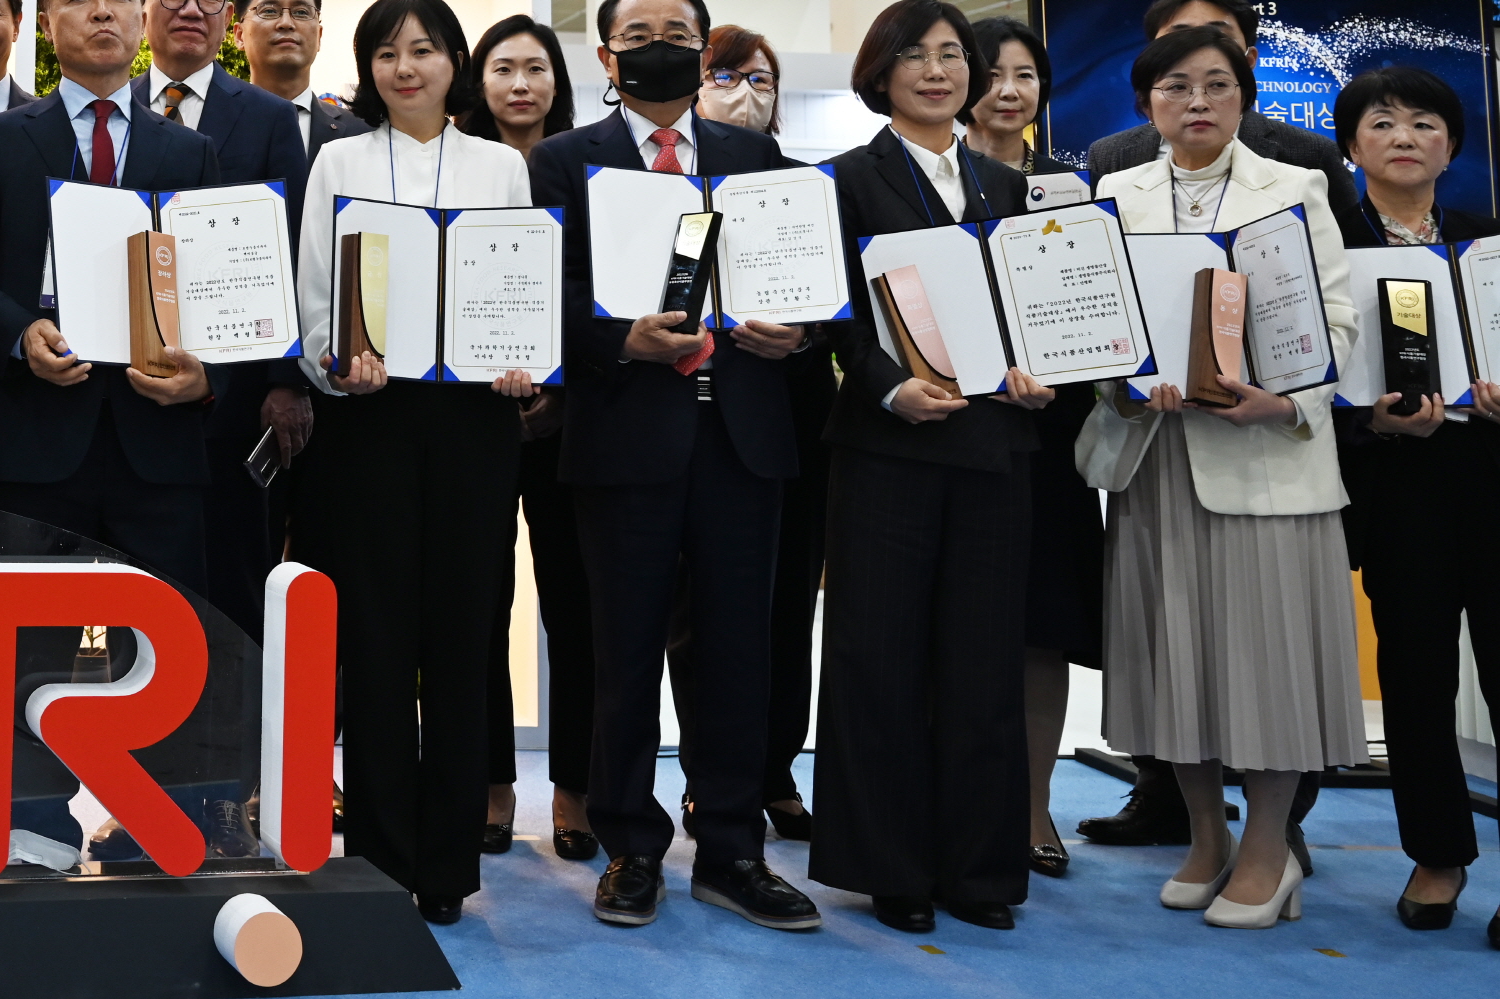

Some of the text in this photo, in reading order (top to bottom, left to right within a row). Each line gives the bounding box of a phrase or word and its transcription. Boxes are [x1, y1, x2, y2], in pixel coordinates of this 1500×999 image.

[1252, 1, 1277, 16] rt 3
[1260, 57, 1288, 68] KFRI
[1256, 81, 1332, 93] CHNOLOGY
[489, 242, 519, 252] 상 장
[1038, 240, 1075, 254] 상 장
[1075, 292, 1117, 303] 한국식품연구원
